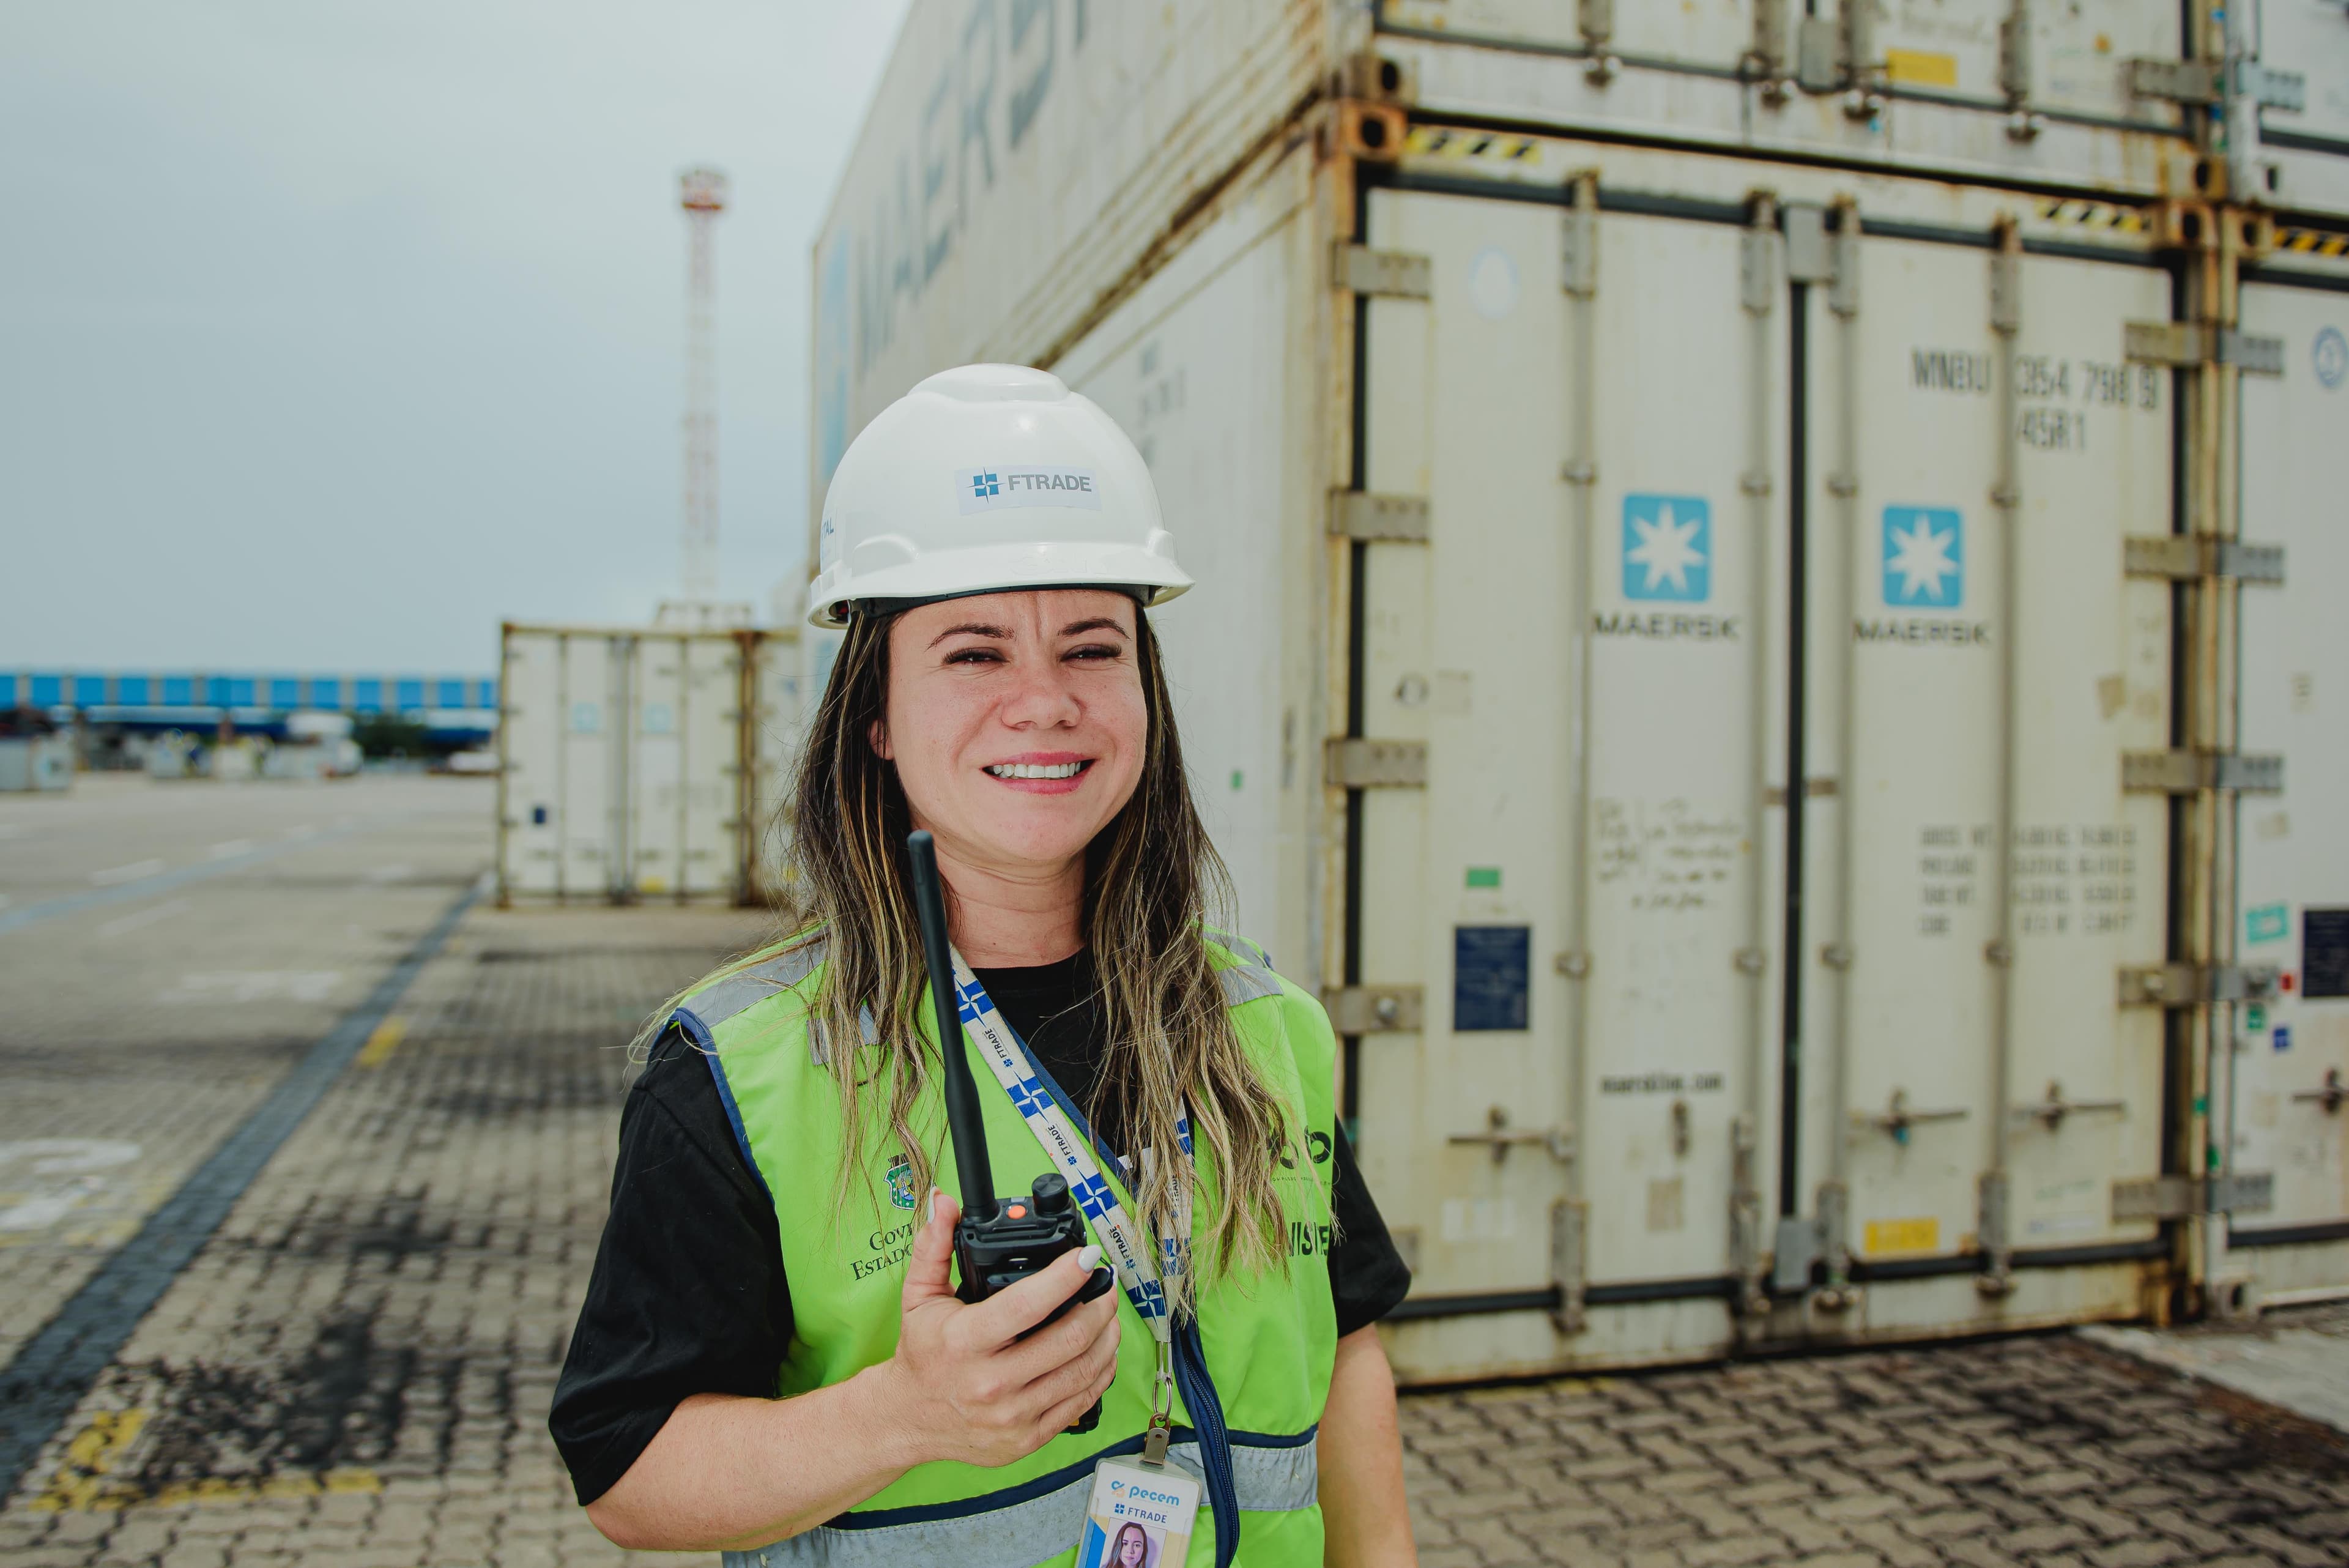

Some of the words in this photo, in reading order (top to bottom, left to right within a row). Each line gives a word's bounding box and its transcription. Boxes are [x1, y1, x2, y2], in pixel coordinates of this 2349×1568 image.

[1008, 474, 1092, 492] FTRADE
[1594, 612, 1741, 638] MAERSK
[1852, 620, 1991, 644] MAERSK
[984, 1028, 1008, 1058] FTRADE
[1048, 1124, 1071, 1156] FTRADE
[1127, 1507, 1168, 1523] FTRADE
